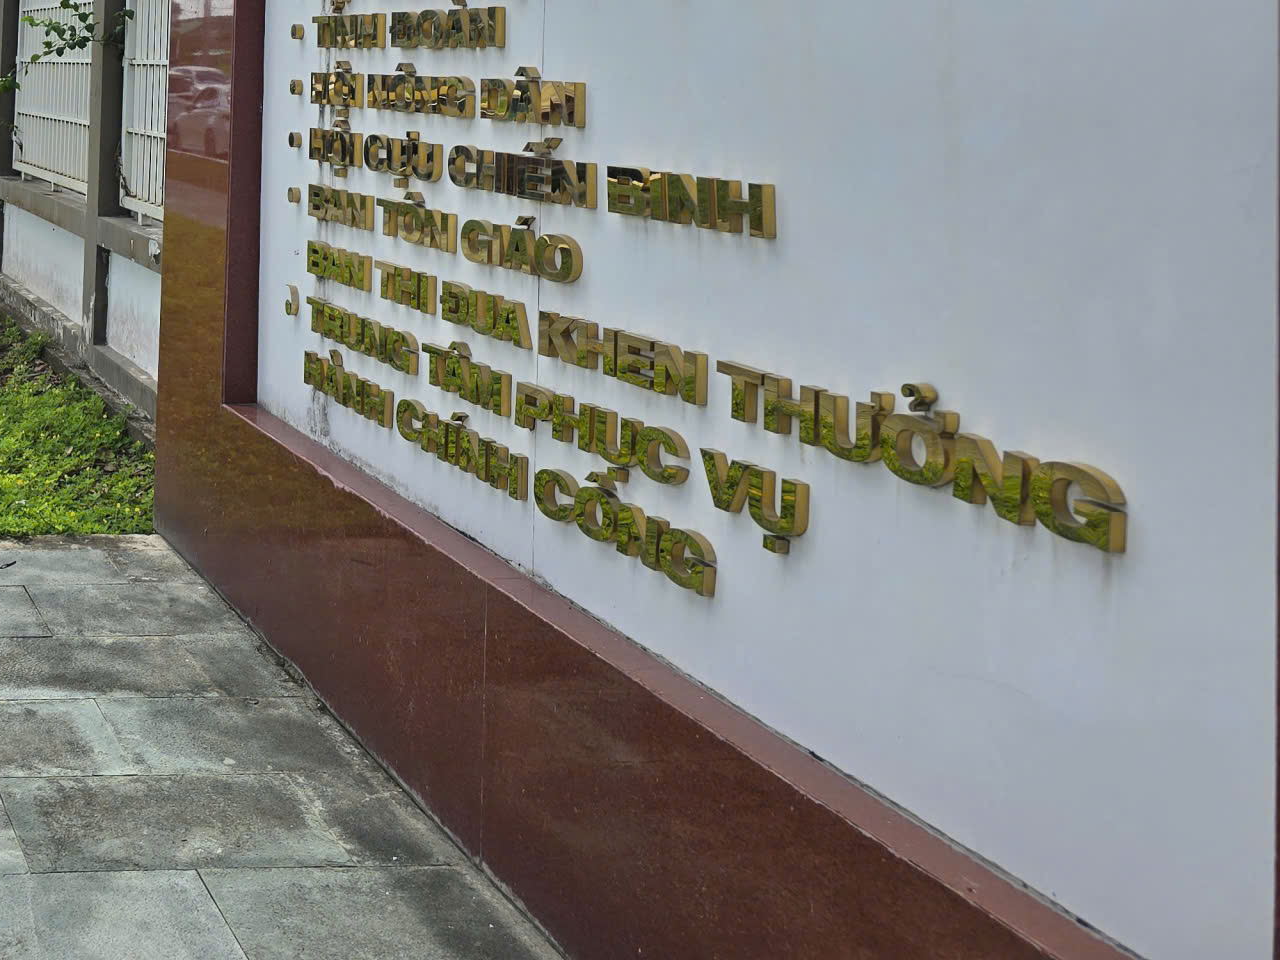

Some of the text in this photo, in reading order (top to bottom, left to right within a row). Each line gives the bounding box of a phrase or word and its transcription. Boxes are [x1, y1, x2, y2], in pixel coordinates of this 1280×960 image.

[309, 120, 777, 239] HỘI CỰU CHIẾN BINH
[310, 61, 586, 128] HỘI NÔNG DÂN
[308, 183, 583, 283] BAN TÔN GIÁO
[304, 349, 717, 597] HÀNH CHÍNH CÔNG
[306, 296, 809, 554] TRUNG TÂM PHỤC VỤ
[307, 240, 1127, 554] BAN THI ĐUA KHEN THƯỞNG
